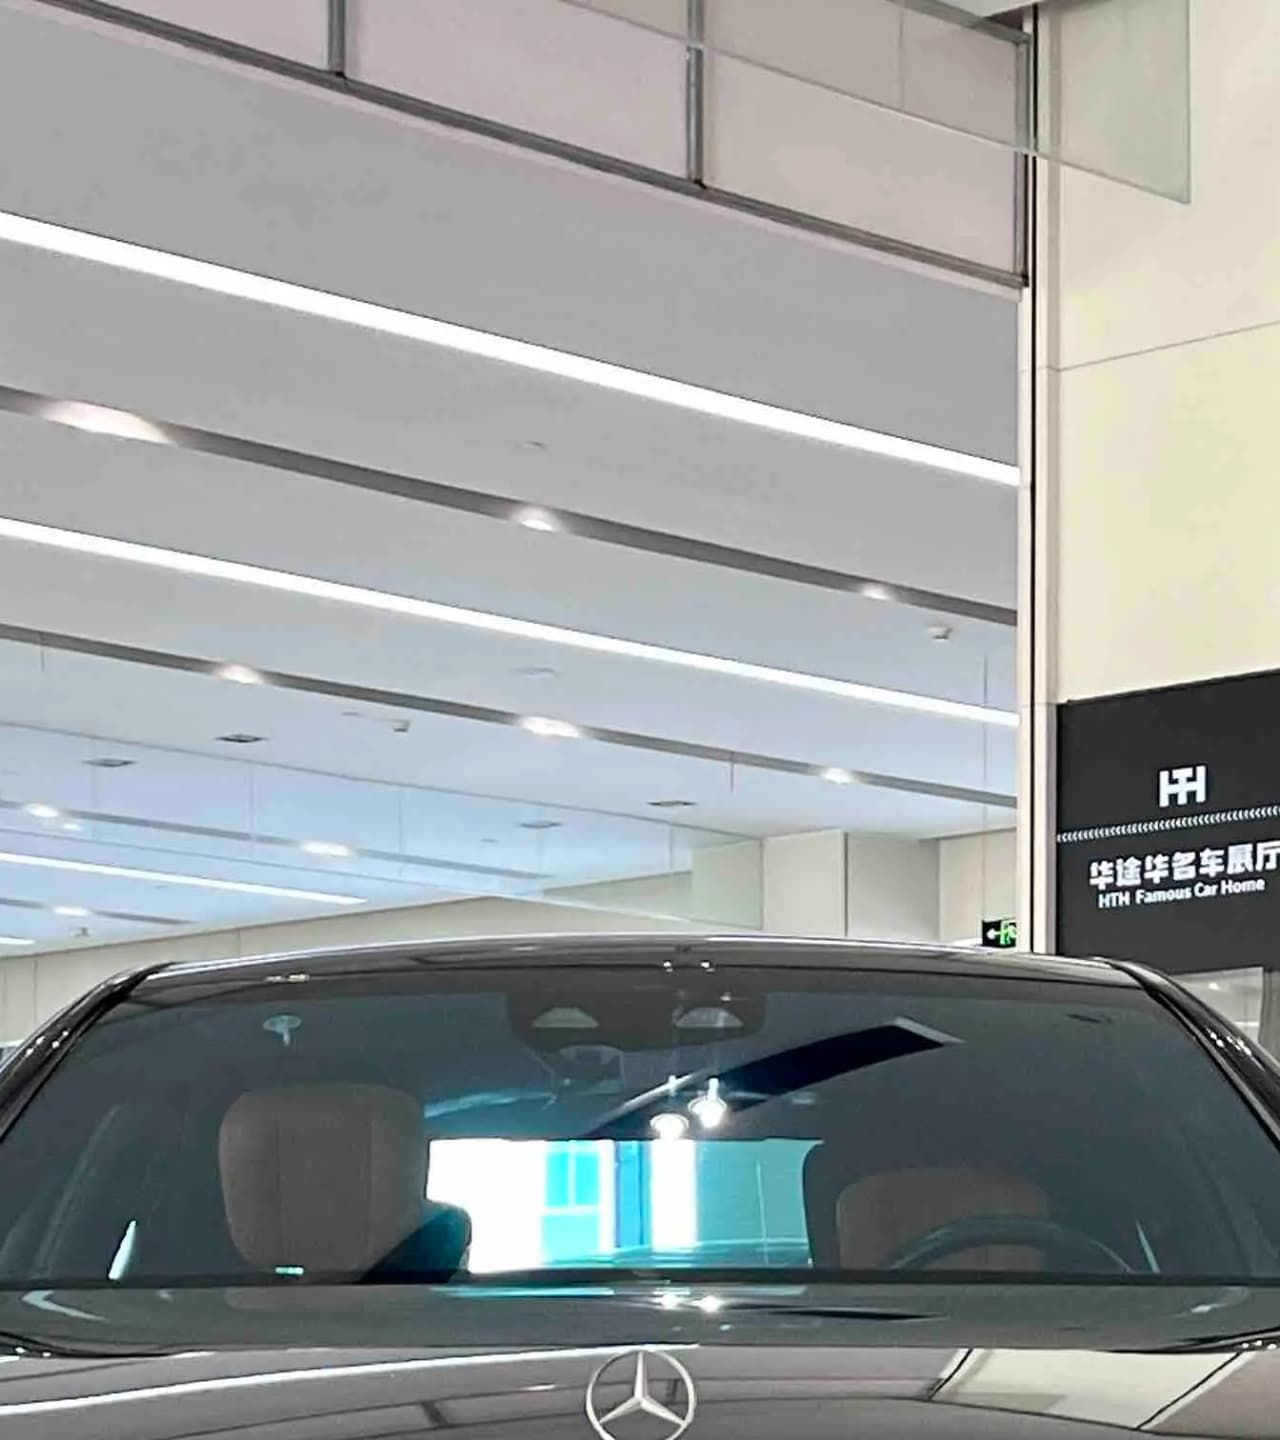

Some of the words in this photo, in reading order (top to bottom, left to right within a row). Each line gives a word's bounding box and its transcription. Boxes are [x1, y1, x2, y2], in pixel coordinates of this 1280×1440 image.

[1098, 893, 1131, 909] HTH
[1135, 886, 1192, 905] Famous
[1194, 881, 1218, 898] Car
[1220, 877, 1266, 896] Home
